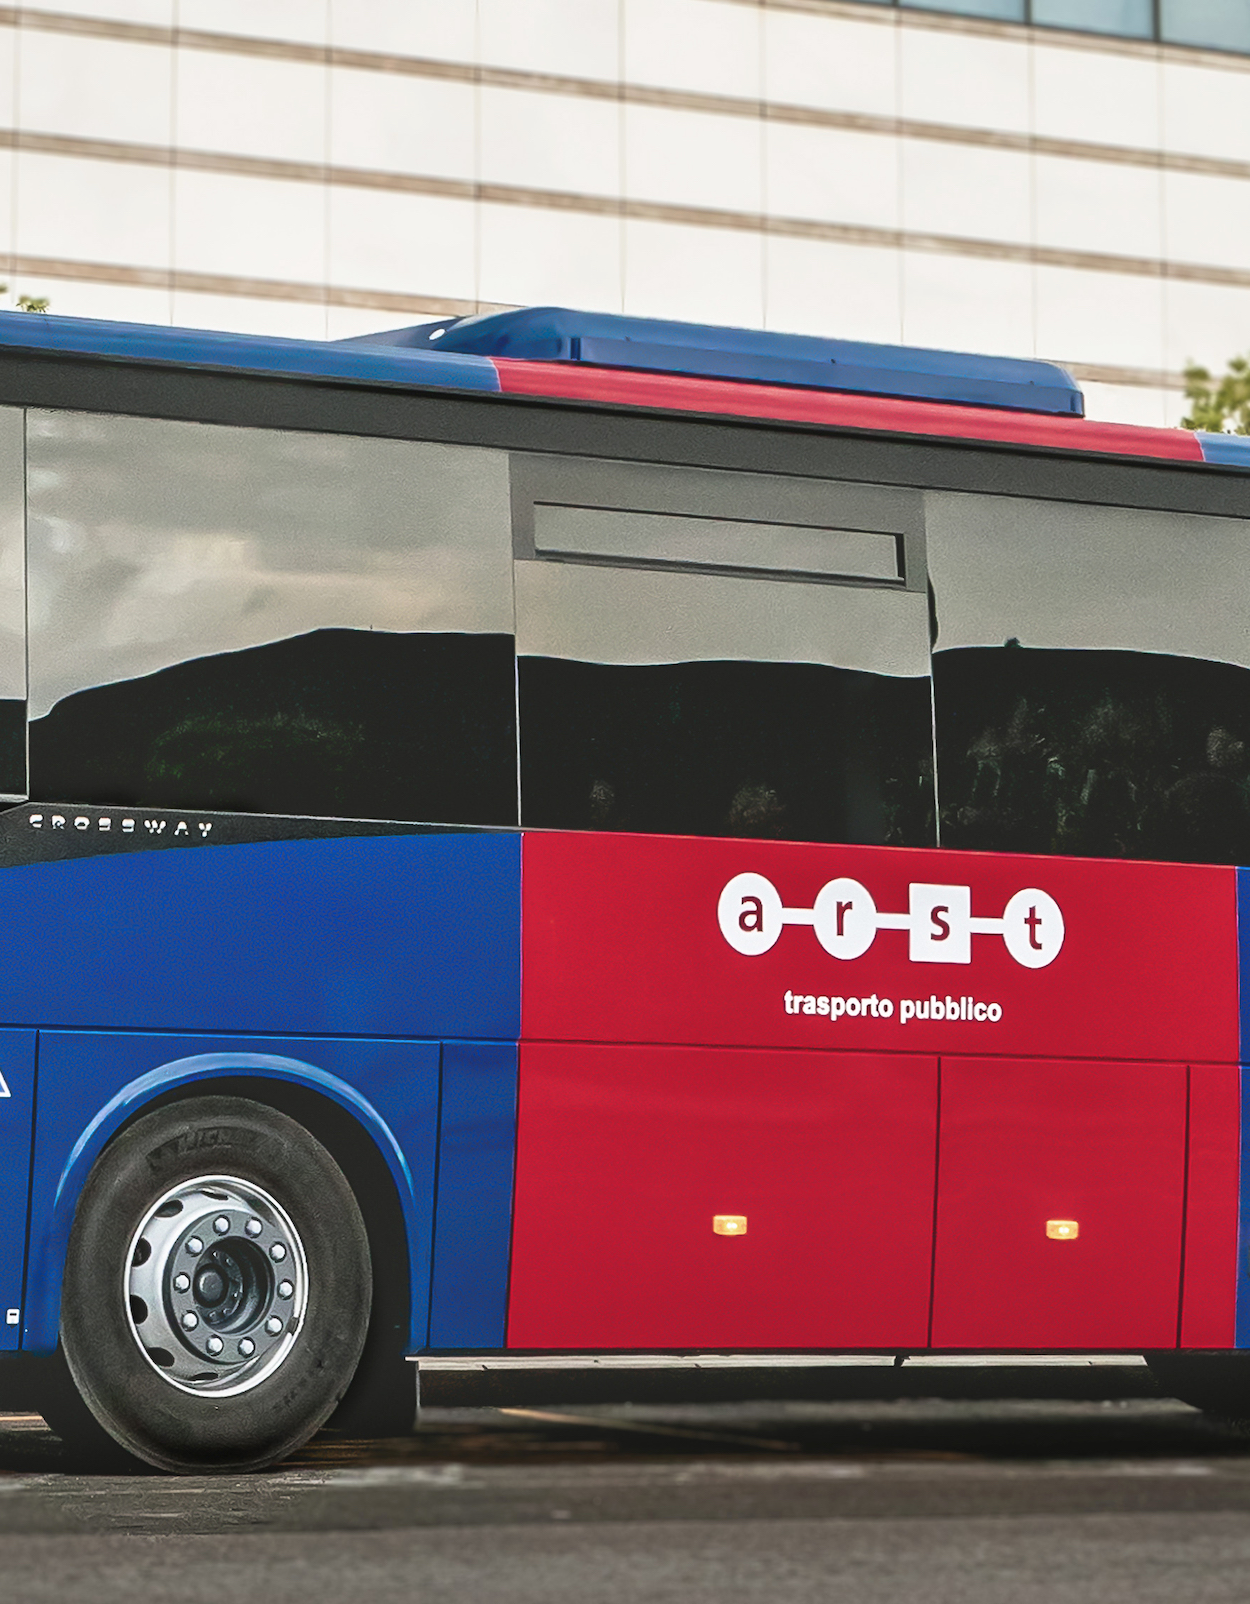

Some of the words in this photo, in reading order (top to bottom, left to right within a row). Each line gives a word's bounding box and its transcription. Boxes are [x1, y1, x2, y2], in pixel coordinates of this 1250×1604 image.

[29, 814, 212, 837] CROSSWAY
[736, 894, 1044, 951] arst
[783, 990, 894, 1021] trasporto
[900, 995, 1002, 1023] pubblico
